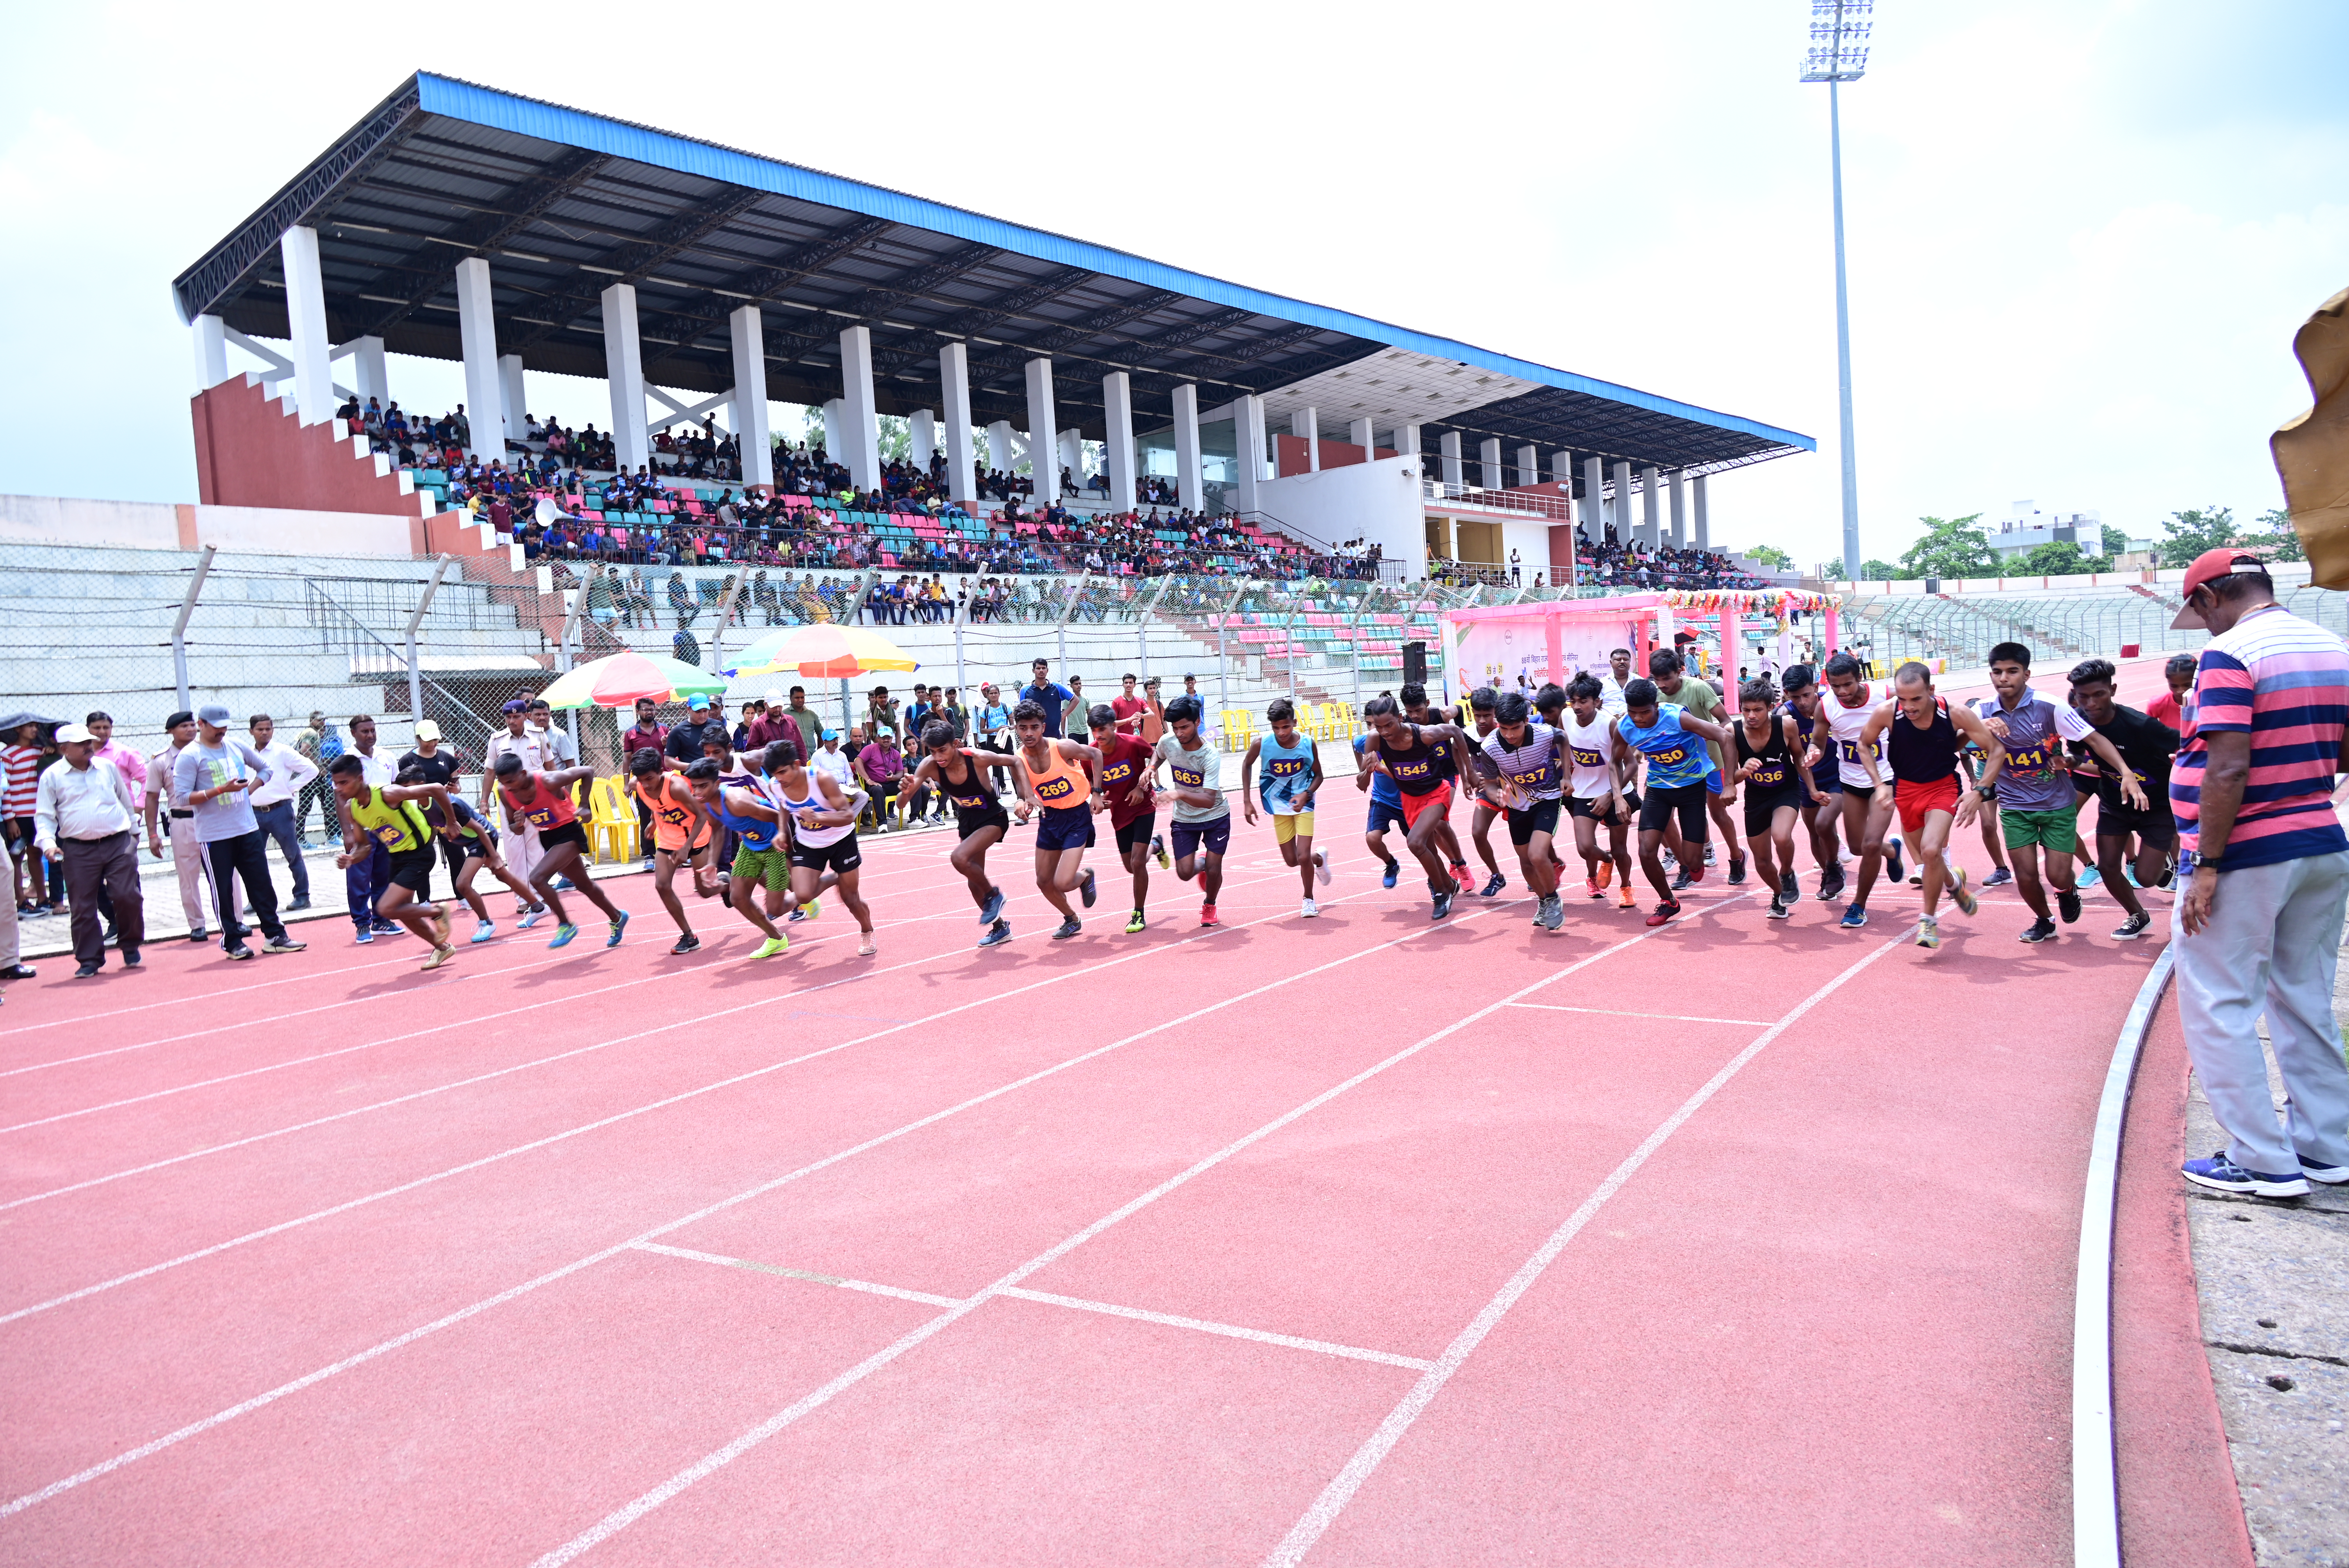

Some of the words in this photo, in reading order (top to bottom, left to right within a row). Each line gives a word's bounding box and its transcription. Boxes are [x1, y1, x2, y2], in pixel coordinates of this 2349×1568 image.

[1531, 654, 1540, 663] बिहार
[1567, 653, 1578, 661] सीनियर
[1572, 750, 1598, 763] 527
[1650, 750, 1683, 763] 250
[2005, 750, 2042, 766] 141
[1103, 764, 1131, 781] 323
[1274, 762, 1301, 773] 311
[1395, 762, 1428, 775] 1545
[1174, 770, 1201, 784] 663
[1514, 768, 1545, 784] 637
[1039, 780, 1069, 796] 269
